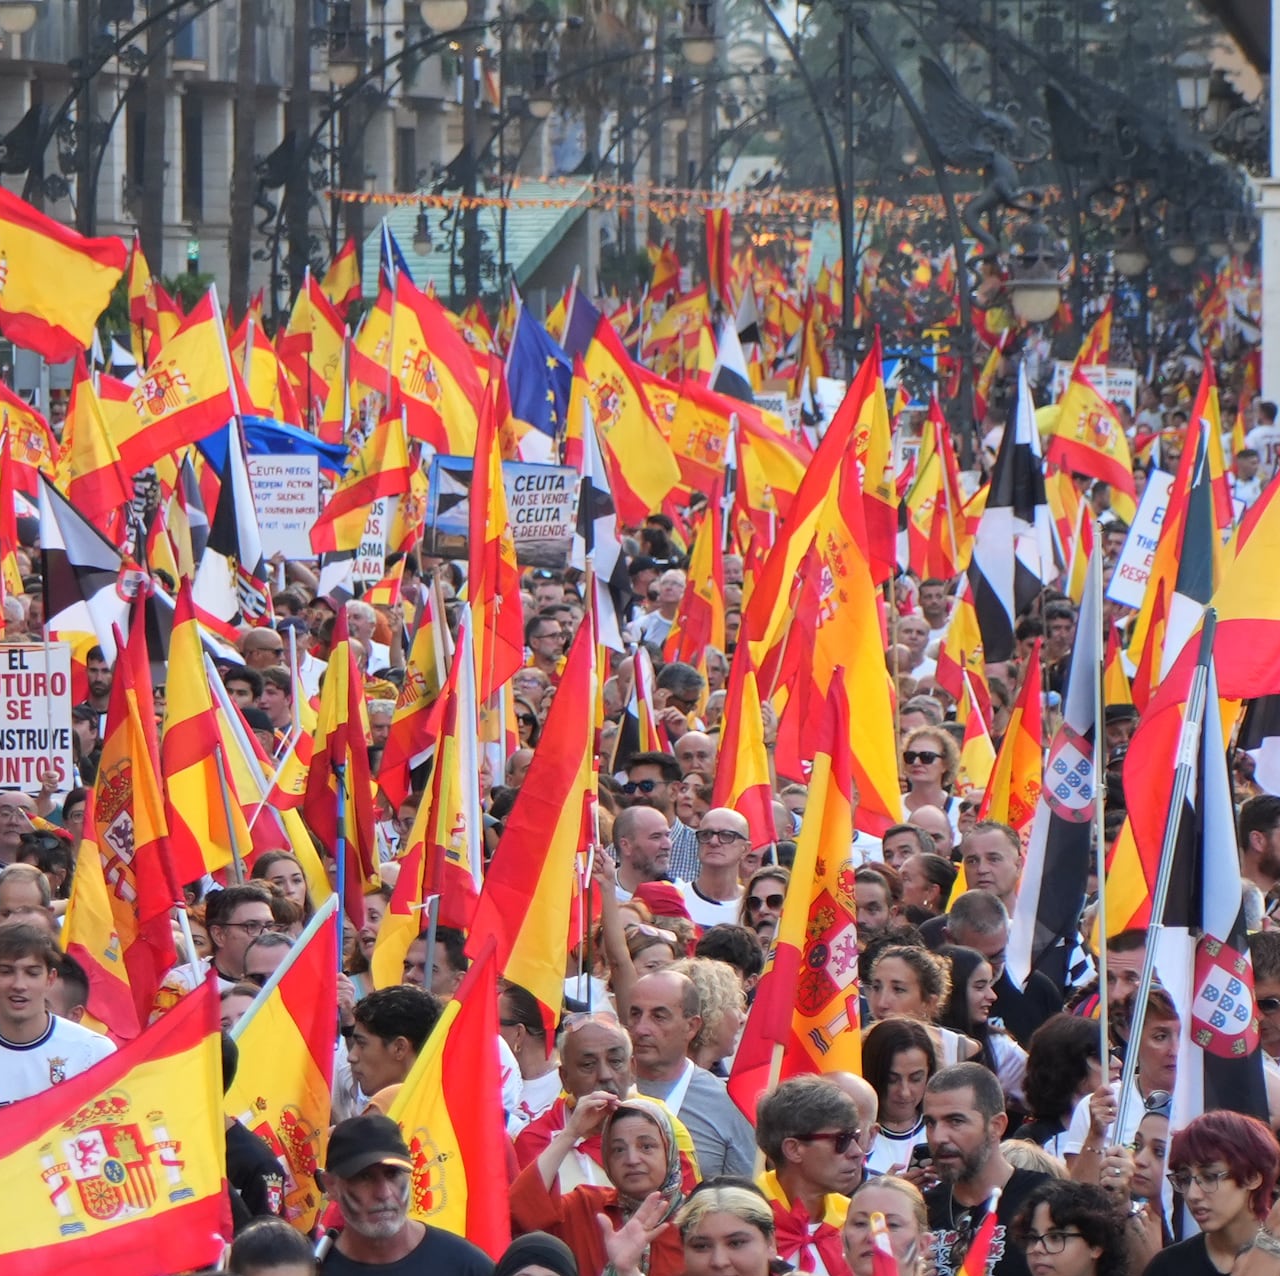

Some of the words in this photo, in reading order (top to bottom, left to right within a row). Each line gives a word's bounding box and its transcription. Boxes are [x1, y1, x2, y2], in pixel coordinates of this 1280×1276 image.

[248, 461, 283, 476] CEUTA
[515, 475, 565, 492] CEUTA
[512, 494, 525, 506] NO
[528, 493, 539, 505] SE
[541, 492, 569, 504] VENDE
[516, 507, 560, 523] CEUTA
[511, 525, 518, 538] E
[521, 524, 567, 537] DEFIENDE
[358, 543, 383, 558] ISMA
[352, 559, 382, 575] AÑA
[1120, 563, 1150, 585] RESP
[8, 649, 29, 670] EL
[6, 700, 32, 720] SE
